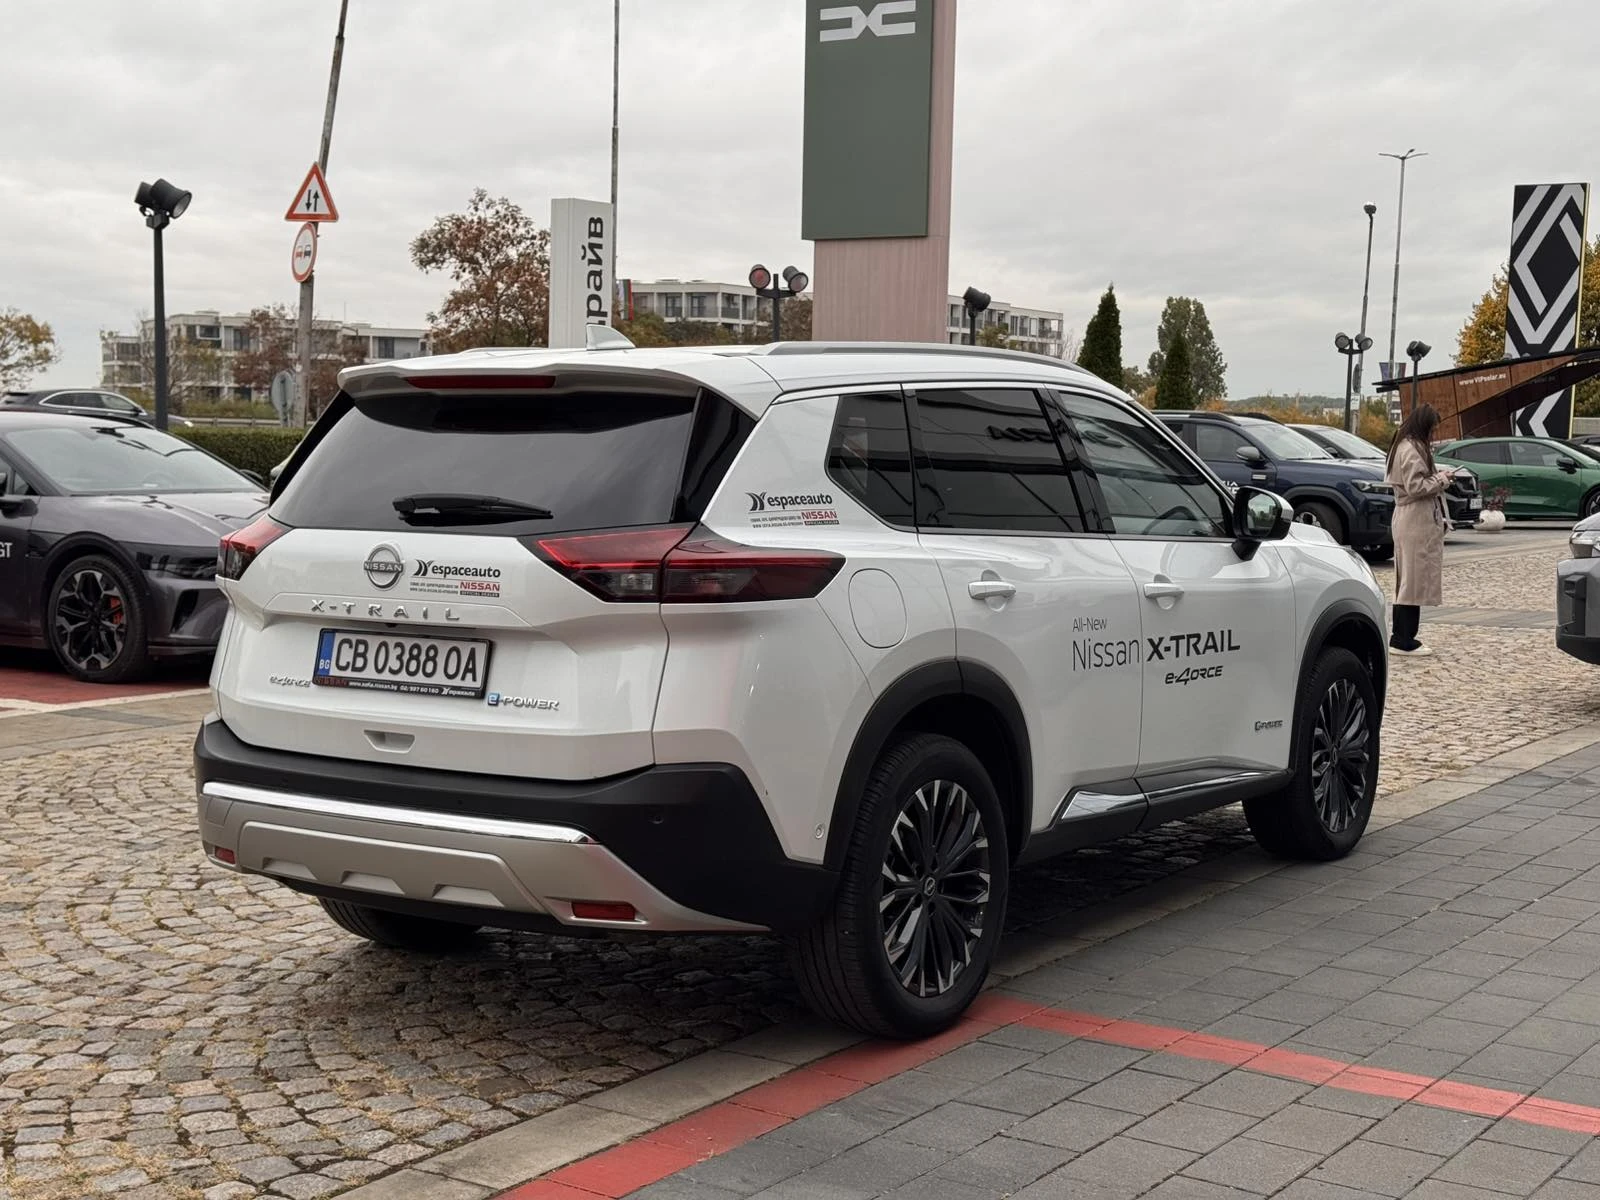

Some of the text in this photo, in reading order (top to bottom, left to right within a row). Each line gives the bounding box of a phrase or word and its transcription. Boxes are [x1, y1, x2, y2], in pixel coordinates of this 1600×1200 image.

[767, 493, 833, 509] espaceauto
[801, 511, 837, 520] NISSAN
[364, 561, 403, 573] NISSAN
[431, 564, 501, 579] espaceauto
[460, 581, 500, 592] NISSAN
[311, 599, 460, 621] X-TRAIL
[1072, 617, 1107, 632] All-New
[1072, 629, 1241, 671] Nissan X-TRAIL
[319, 658, 330, 670] BG
[335, 638, 477, 682] CB 0388 OA
